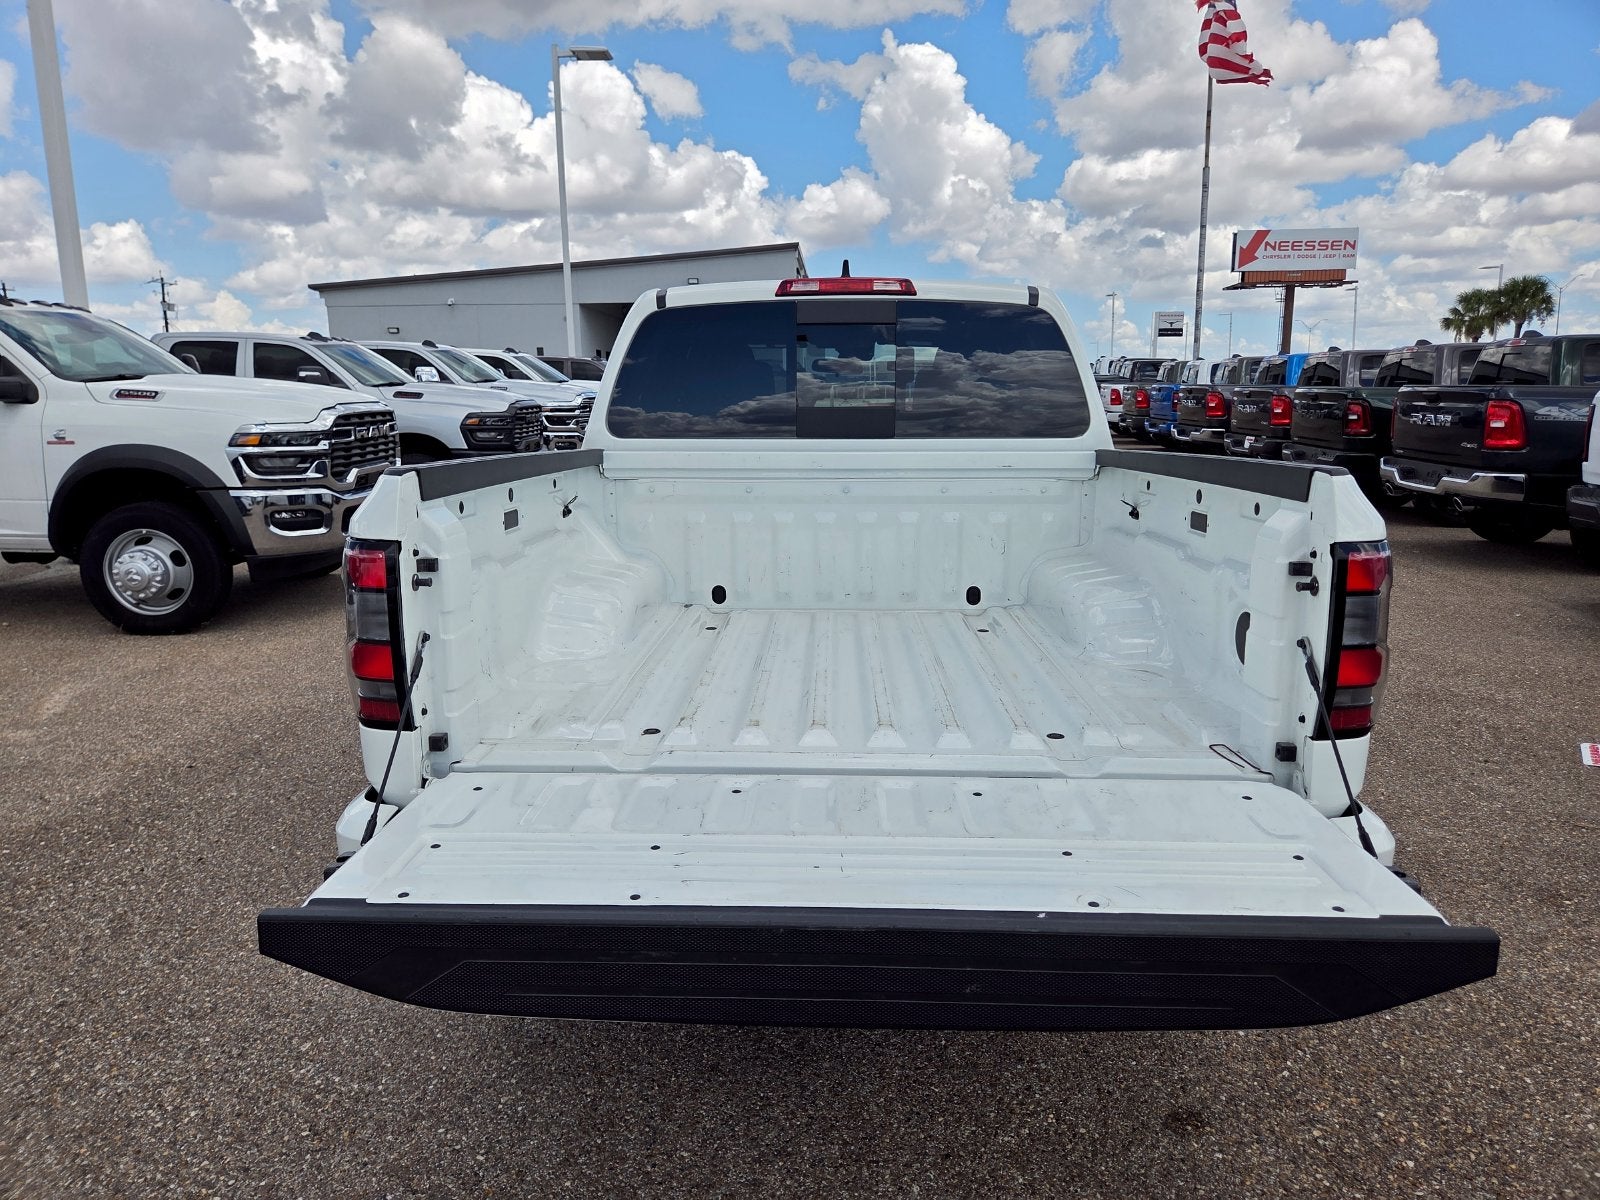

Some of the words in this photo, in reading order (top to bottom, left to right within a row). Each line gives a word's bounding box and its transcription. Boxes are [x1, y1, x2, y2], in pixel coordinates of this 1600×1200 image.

[1263, 239, 1357, 252] NEESSEN
[119, 389, 156, 397] 5500
[1409, 413, 1452, 427] RAM
[355, 422, 392, 440] RAM
